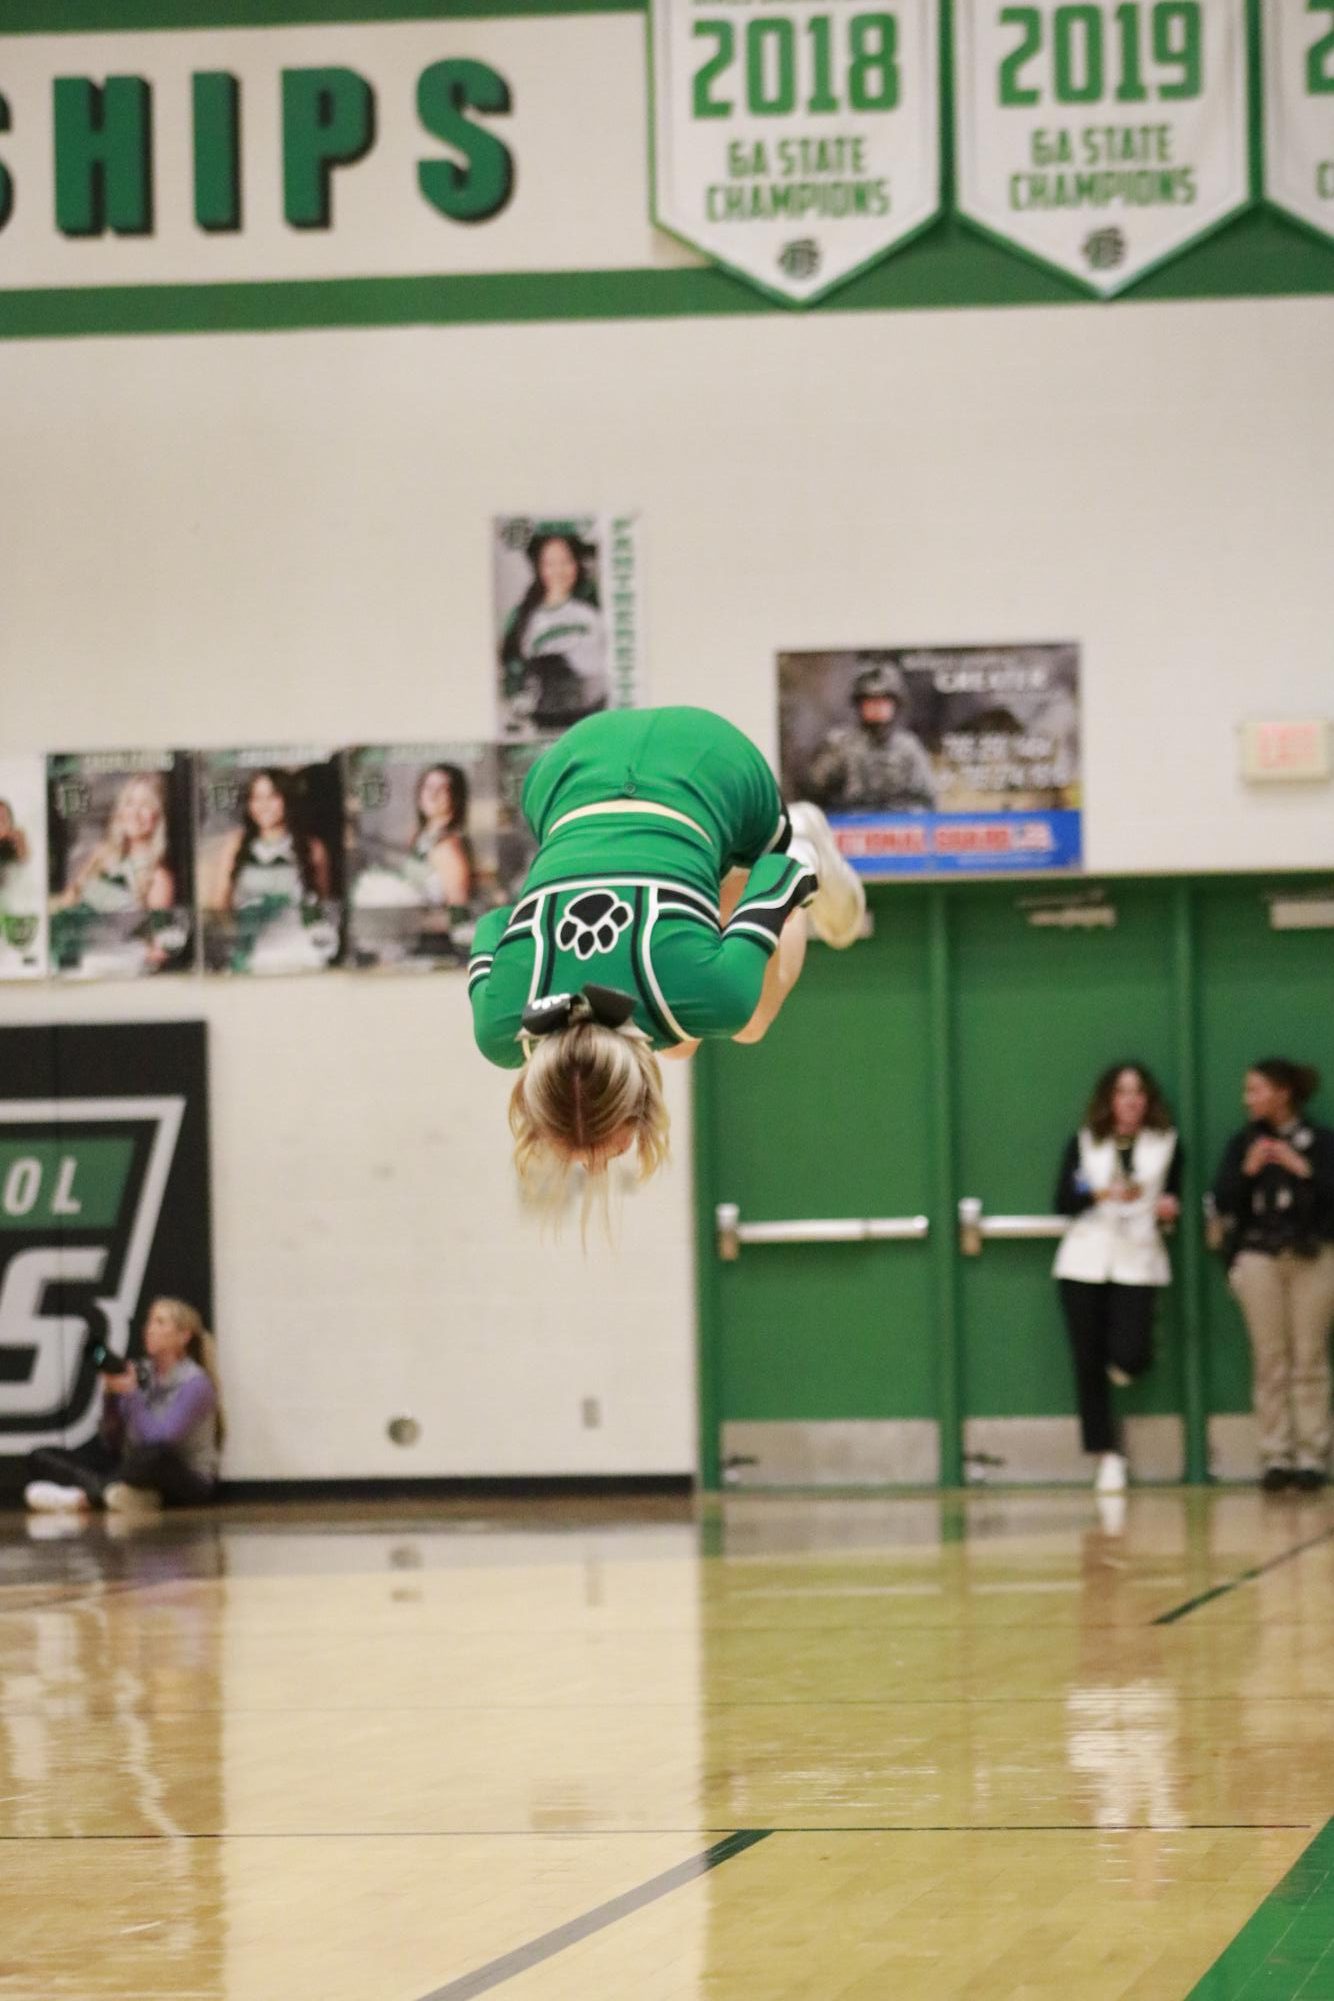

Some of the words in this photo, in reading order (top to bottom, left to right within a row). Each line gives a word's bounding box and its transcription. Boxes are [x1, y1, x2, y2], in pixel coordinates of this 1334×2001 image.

[693, 12, 899, 119] 2018
[1000, 1, 1202, 106] 2019
[0, 56, 517, 241] HIPS
[776, 134, 867, 176] STATE
[1081, 121, 1172, 165] STATE
[706, 176, 893, 223] CHAMPIONS
[1008, 165, 1198, 212] CHAMPIONS
